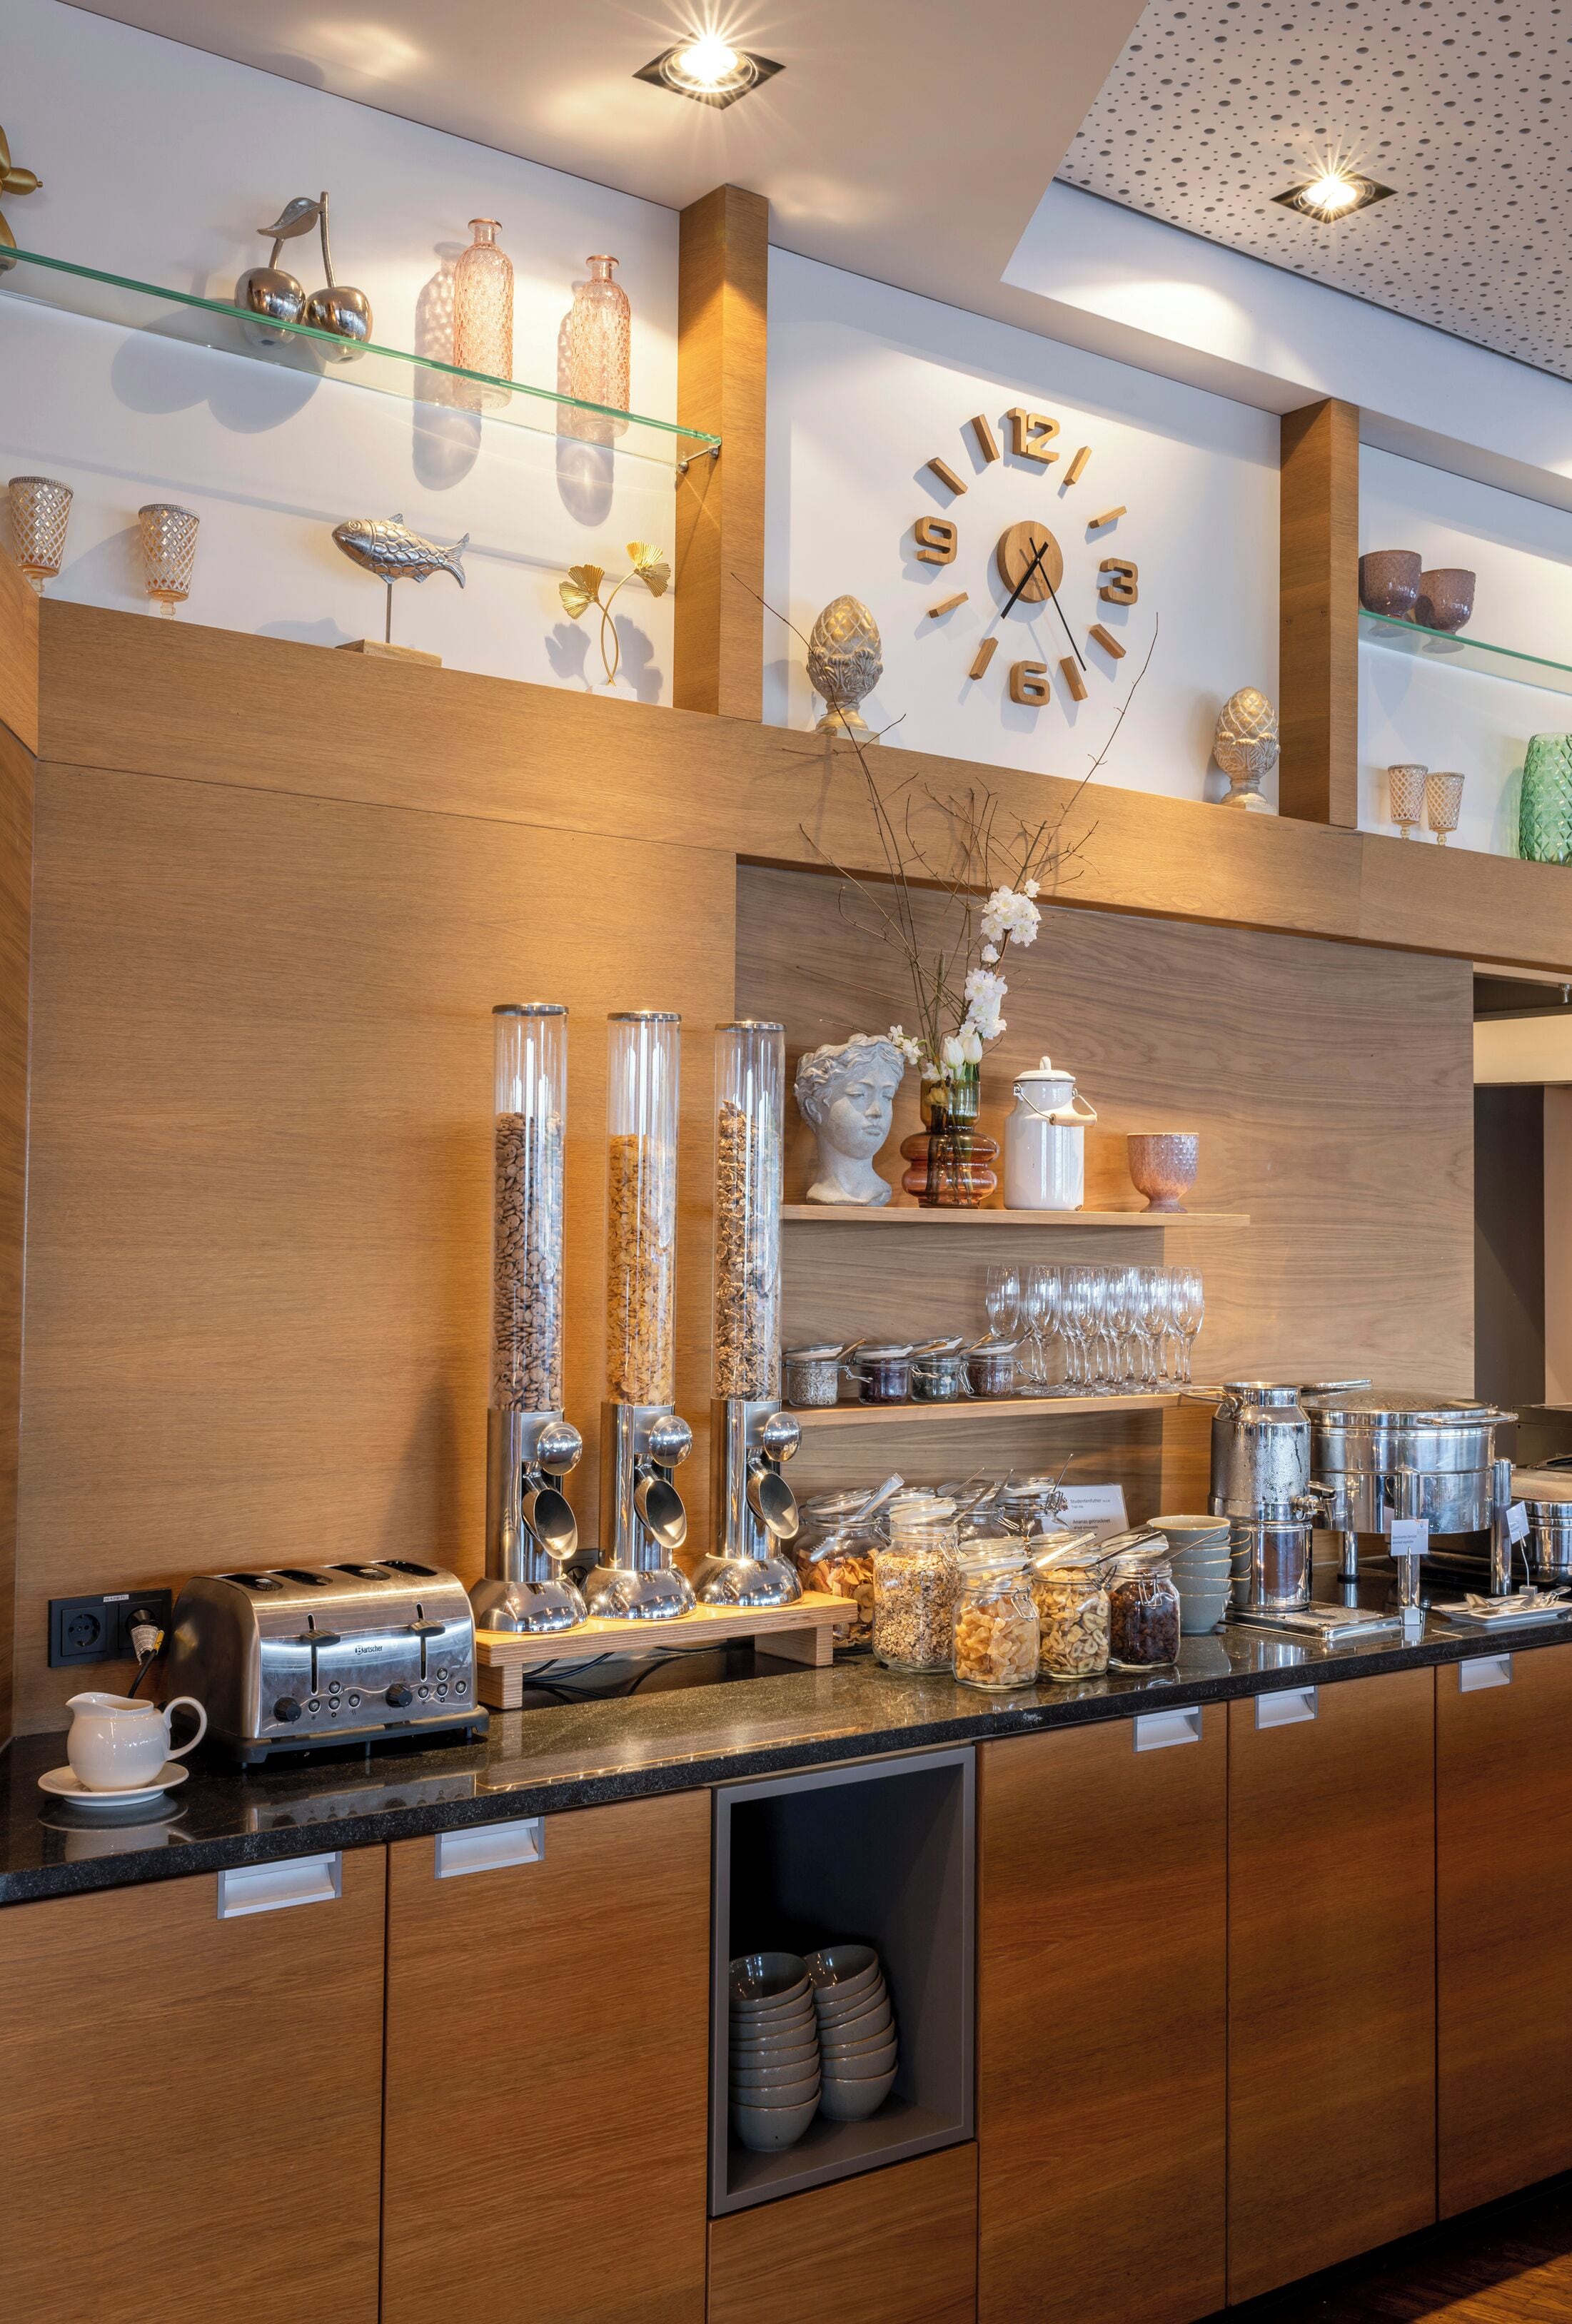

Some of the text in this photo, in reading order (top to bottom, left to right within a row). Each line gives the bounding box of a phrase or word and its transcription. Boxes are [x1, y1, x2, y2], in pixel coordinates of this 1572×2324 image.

[1007, 408, 1060, 464] 12
[915, 515, 957, 566] 9
[1099, 557, 1139, 606] 3
[1009, 660, 1050, 707] 6
[355, 1645, 383, 1655] Bartscher
